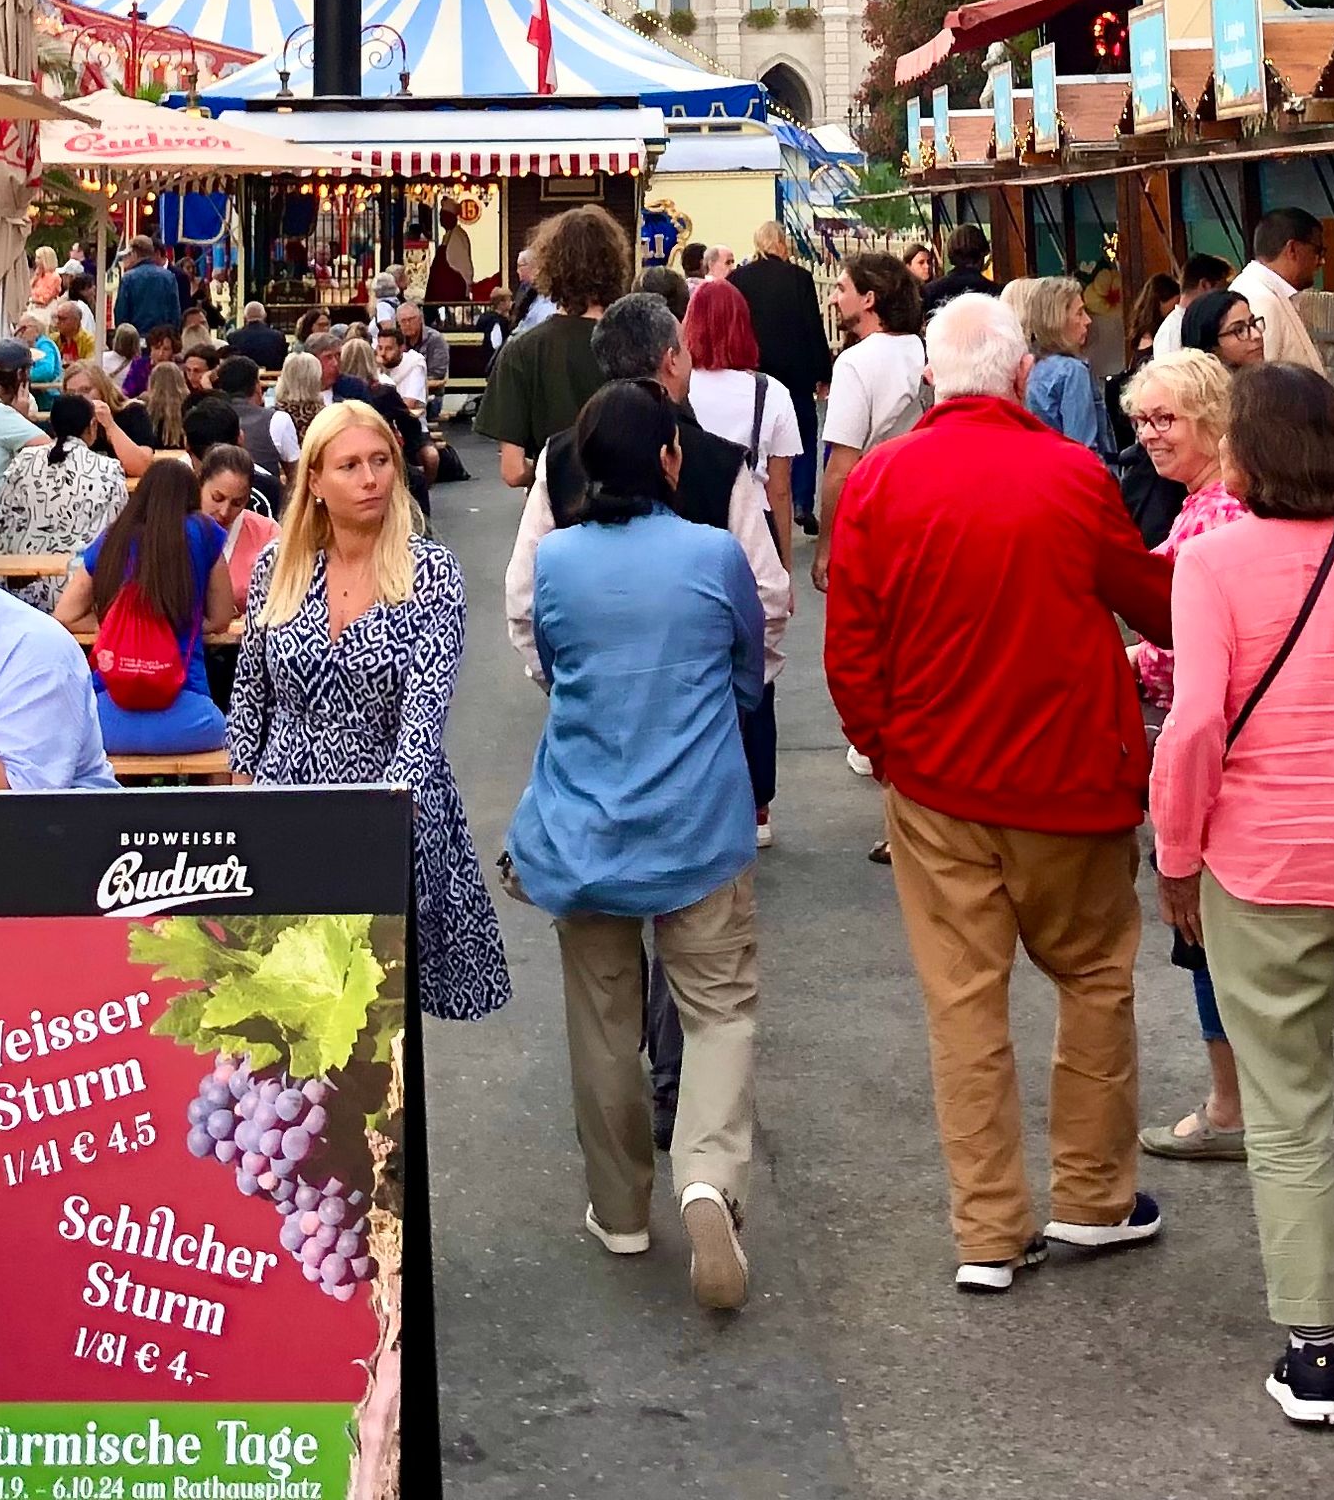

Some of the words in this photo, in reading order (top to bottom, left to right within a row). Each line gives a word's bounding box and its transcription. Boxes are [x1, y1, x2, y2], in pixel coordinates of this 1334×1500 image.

[120, 831, 237, 846] BUDWEISER
[97, 851, 254, 913] Budvar
[70, 1131, 97, 1164] €
[107, 1111, 156, 1153] 4,5
[58, 1195, 278, 1284] Schilcher
[82, 1262, 226, 1336] Sturm
[134, 1342, 160, 1373] €
[217, 1420, 319, 1479] Tage
[52, 1476, 125, 1499] 6.10.24
[132, 1484, 166, 1499] am
[174, 1476, 322, 1500] Rathausplatz
